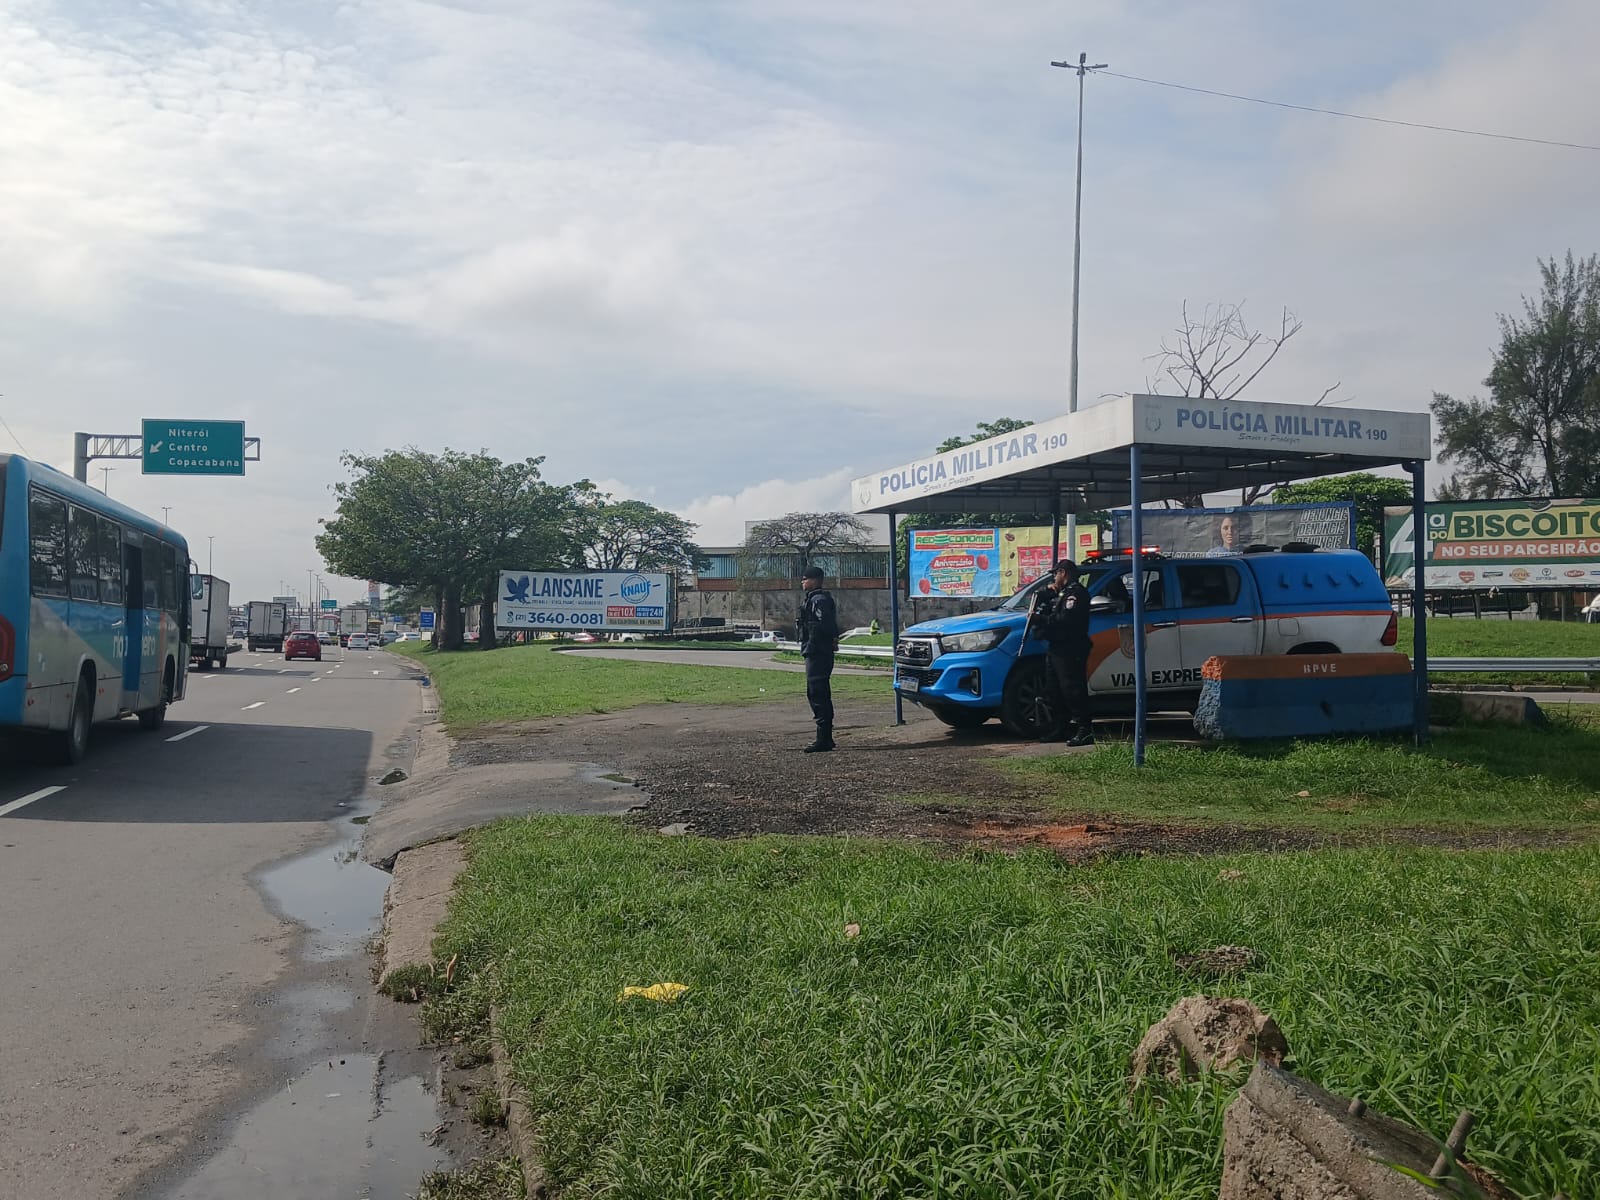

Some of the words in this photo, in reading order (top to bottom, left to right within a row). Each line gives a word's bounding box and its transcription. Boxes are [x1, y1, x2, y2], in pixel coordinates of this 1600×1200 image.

[1176, 407, 1268, 433] POLÍCIA
[1274, 414, 1362, 440] MILITAR
[1365, 429, 1388, 441] 190
[168, 427, 209, 438] Niterói
[168, 443, 208, 452] Centro
[168, 457, 240, 467] Copacabana
[880, 460, 947, 495] POLÍCIA
[952, 432, 1038, 477] MILITAR
[1042, 432, 1068, 451] 190
[1430, 530, 1447, 540] DO
[1441, 544, 1465, 557] NO
[1469, 543, 1500, 557] SEU
[532, 577, 604, 598] LANSANE
[528, 611, 603, 625] 3640-0081
[1111, 672, 1146, 687] VIA
